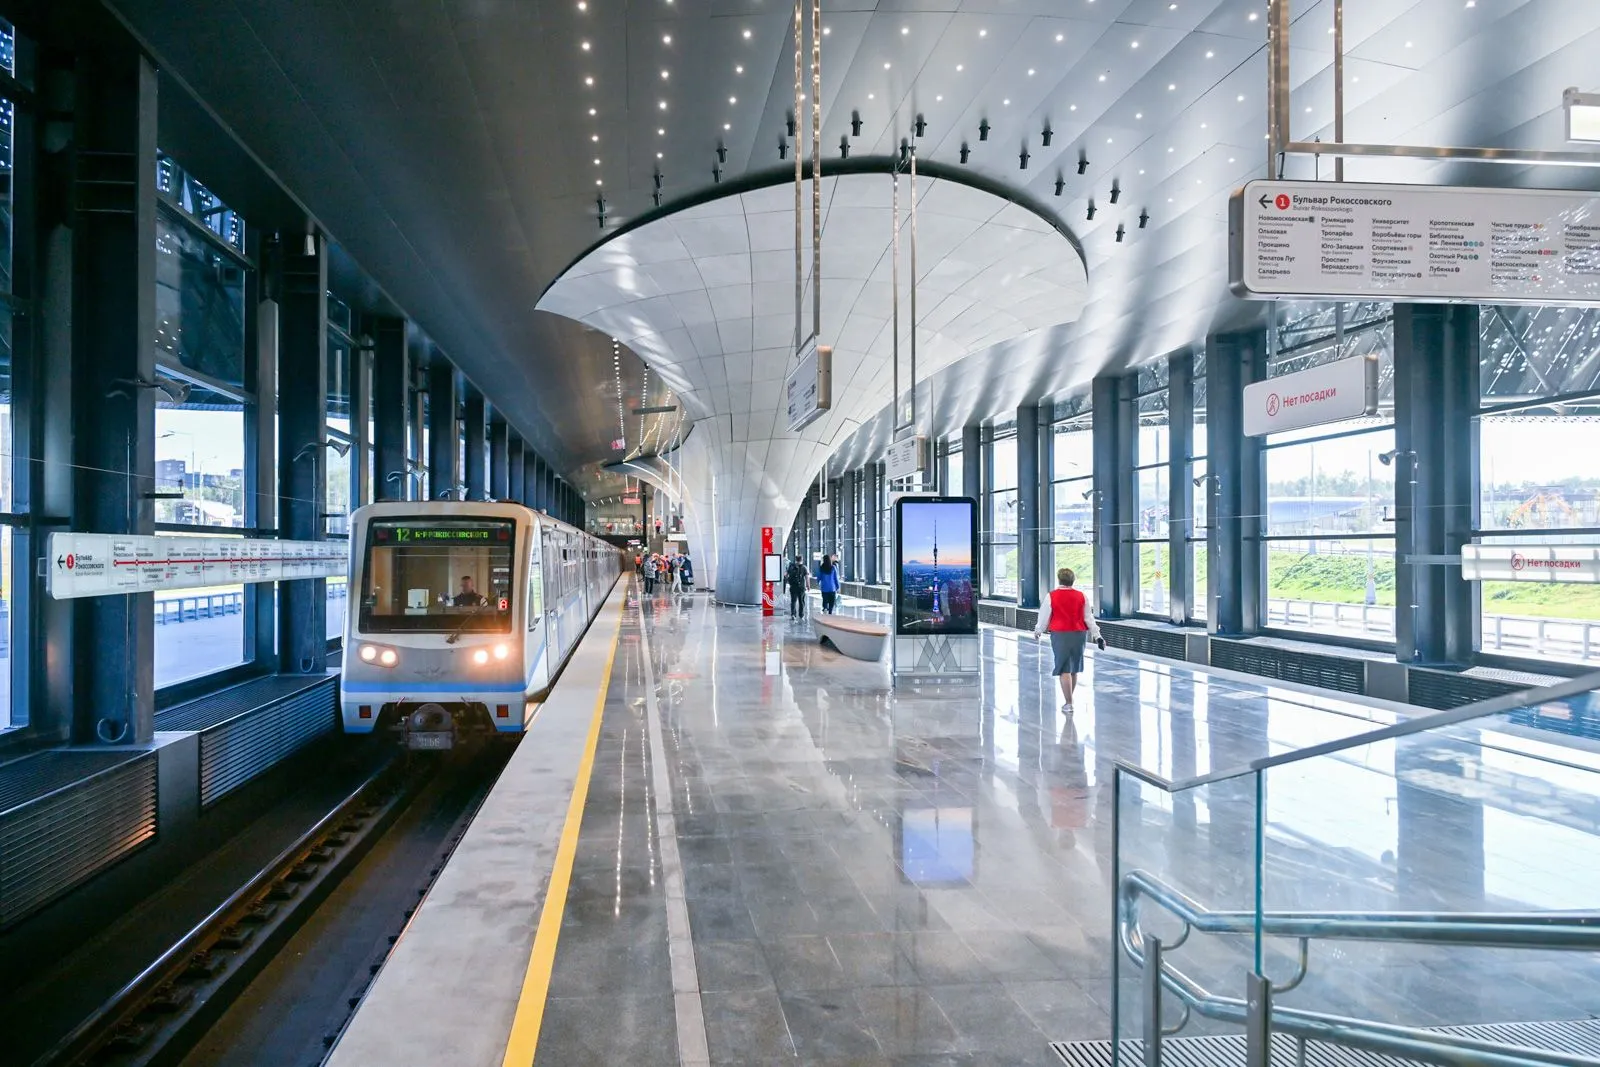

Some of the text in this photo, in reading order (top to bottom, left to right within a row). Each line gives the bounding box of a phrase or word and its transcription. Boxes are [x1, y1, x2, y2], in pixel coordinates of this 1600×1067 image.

[1292, 195, 1328, 206] Бульвар
[1330, 196, 1392, 206] Рокоссовского
[1283, 388, 1336, 407] Нет посадки
[396, 528, 410, 541] 12
[1527, 559, 1581, 568] Нет посадки
